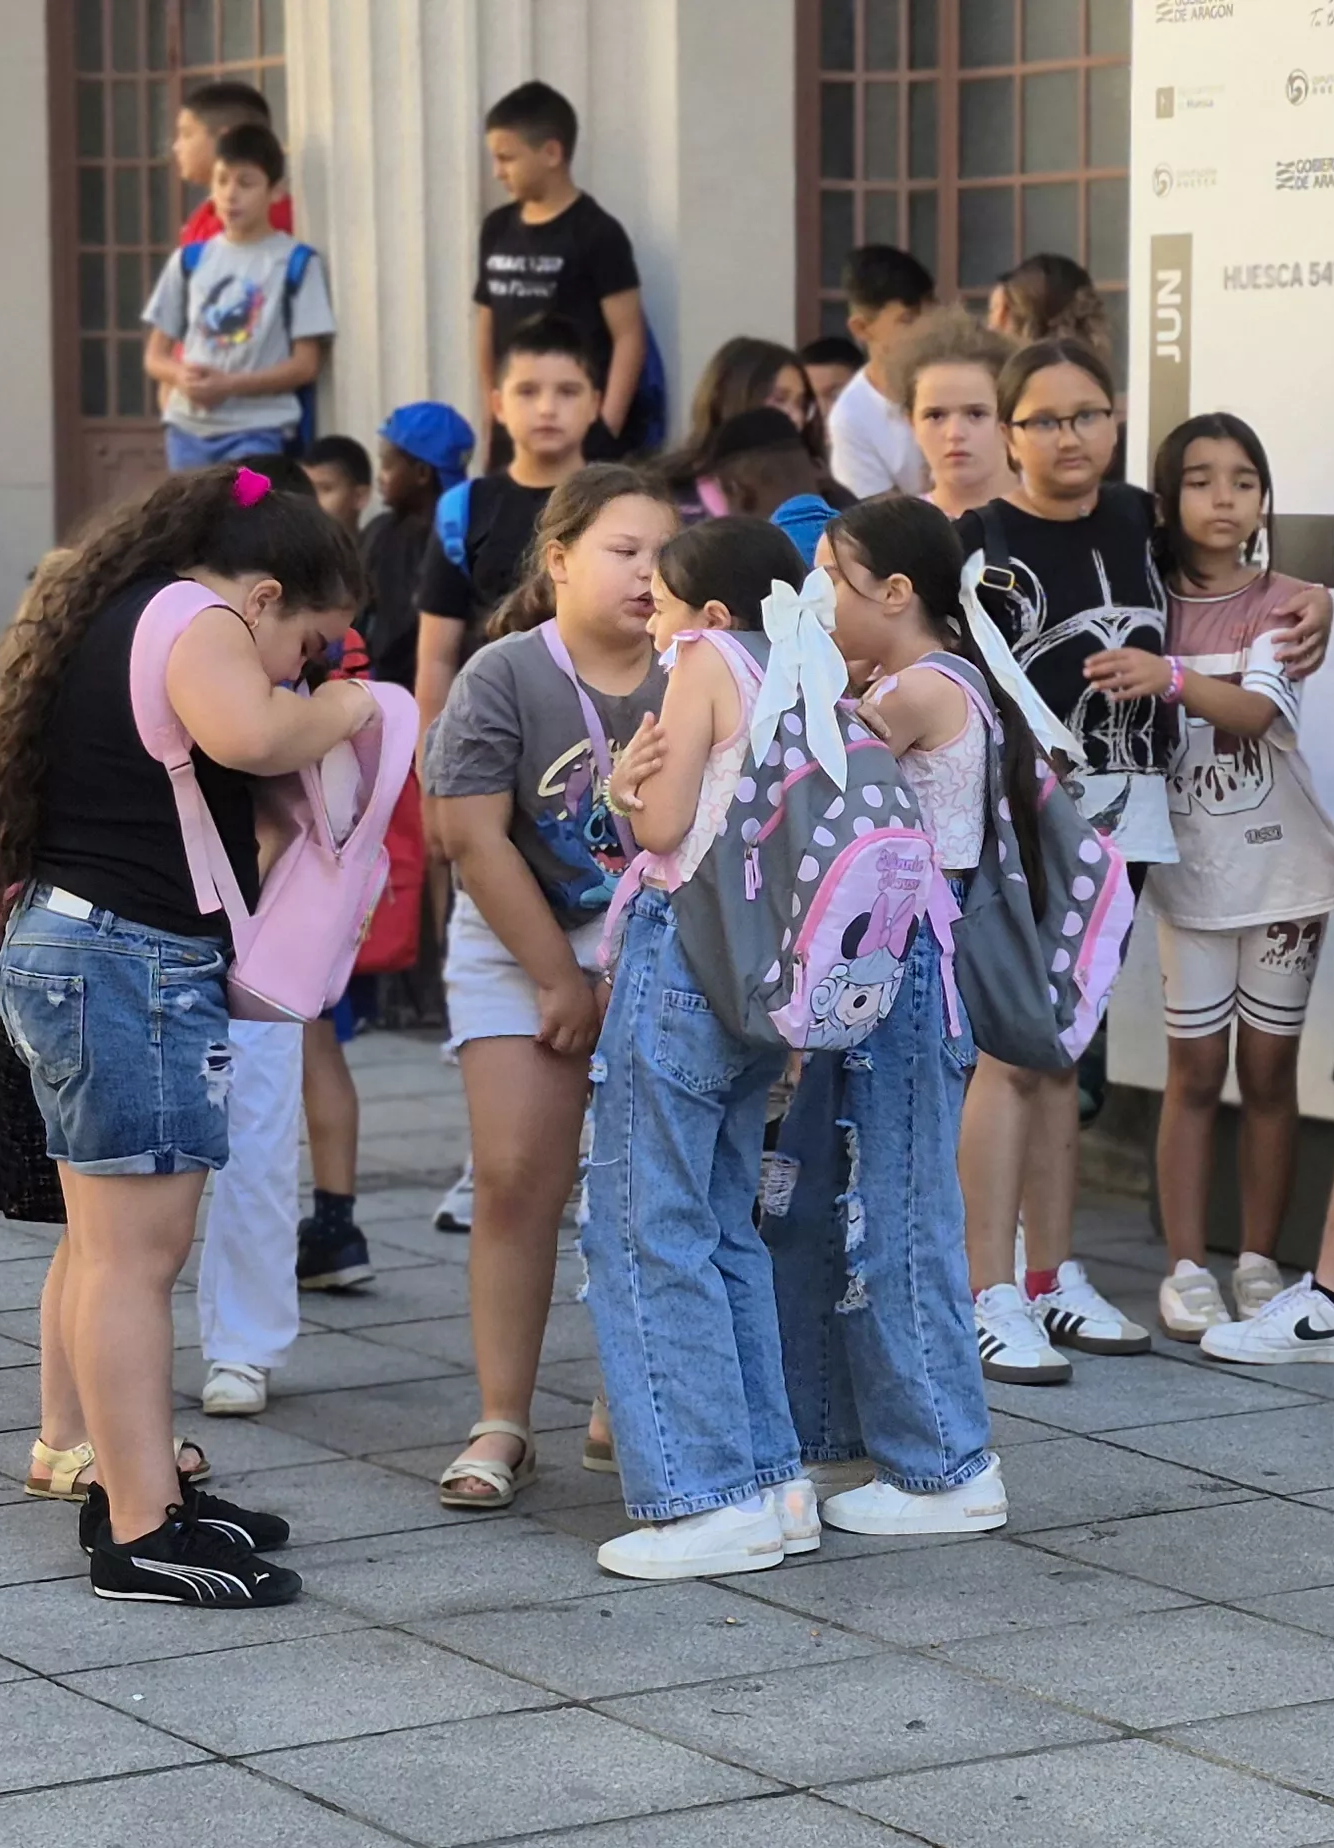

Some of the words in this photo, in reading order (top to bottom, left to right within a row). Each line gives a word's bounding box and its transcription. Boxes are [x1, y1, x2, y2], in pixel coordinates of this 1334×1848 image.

[1295, 175, 1309, 190] DE
[1223, 262, 1304, 291] HUESCA
[1156, 268, 1183, 364] JUN
